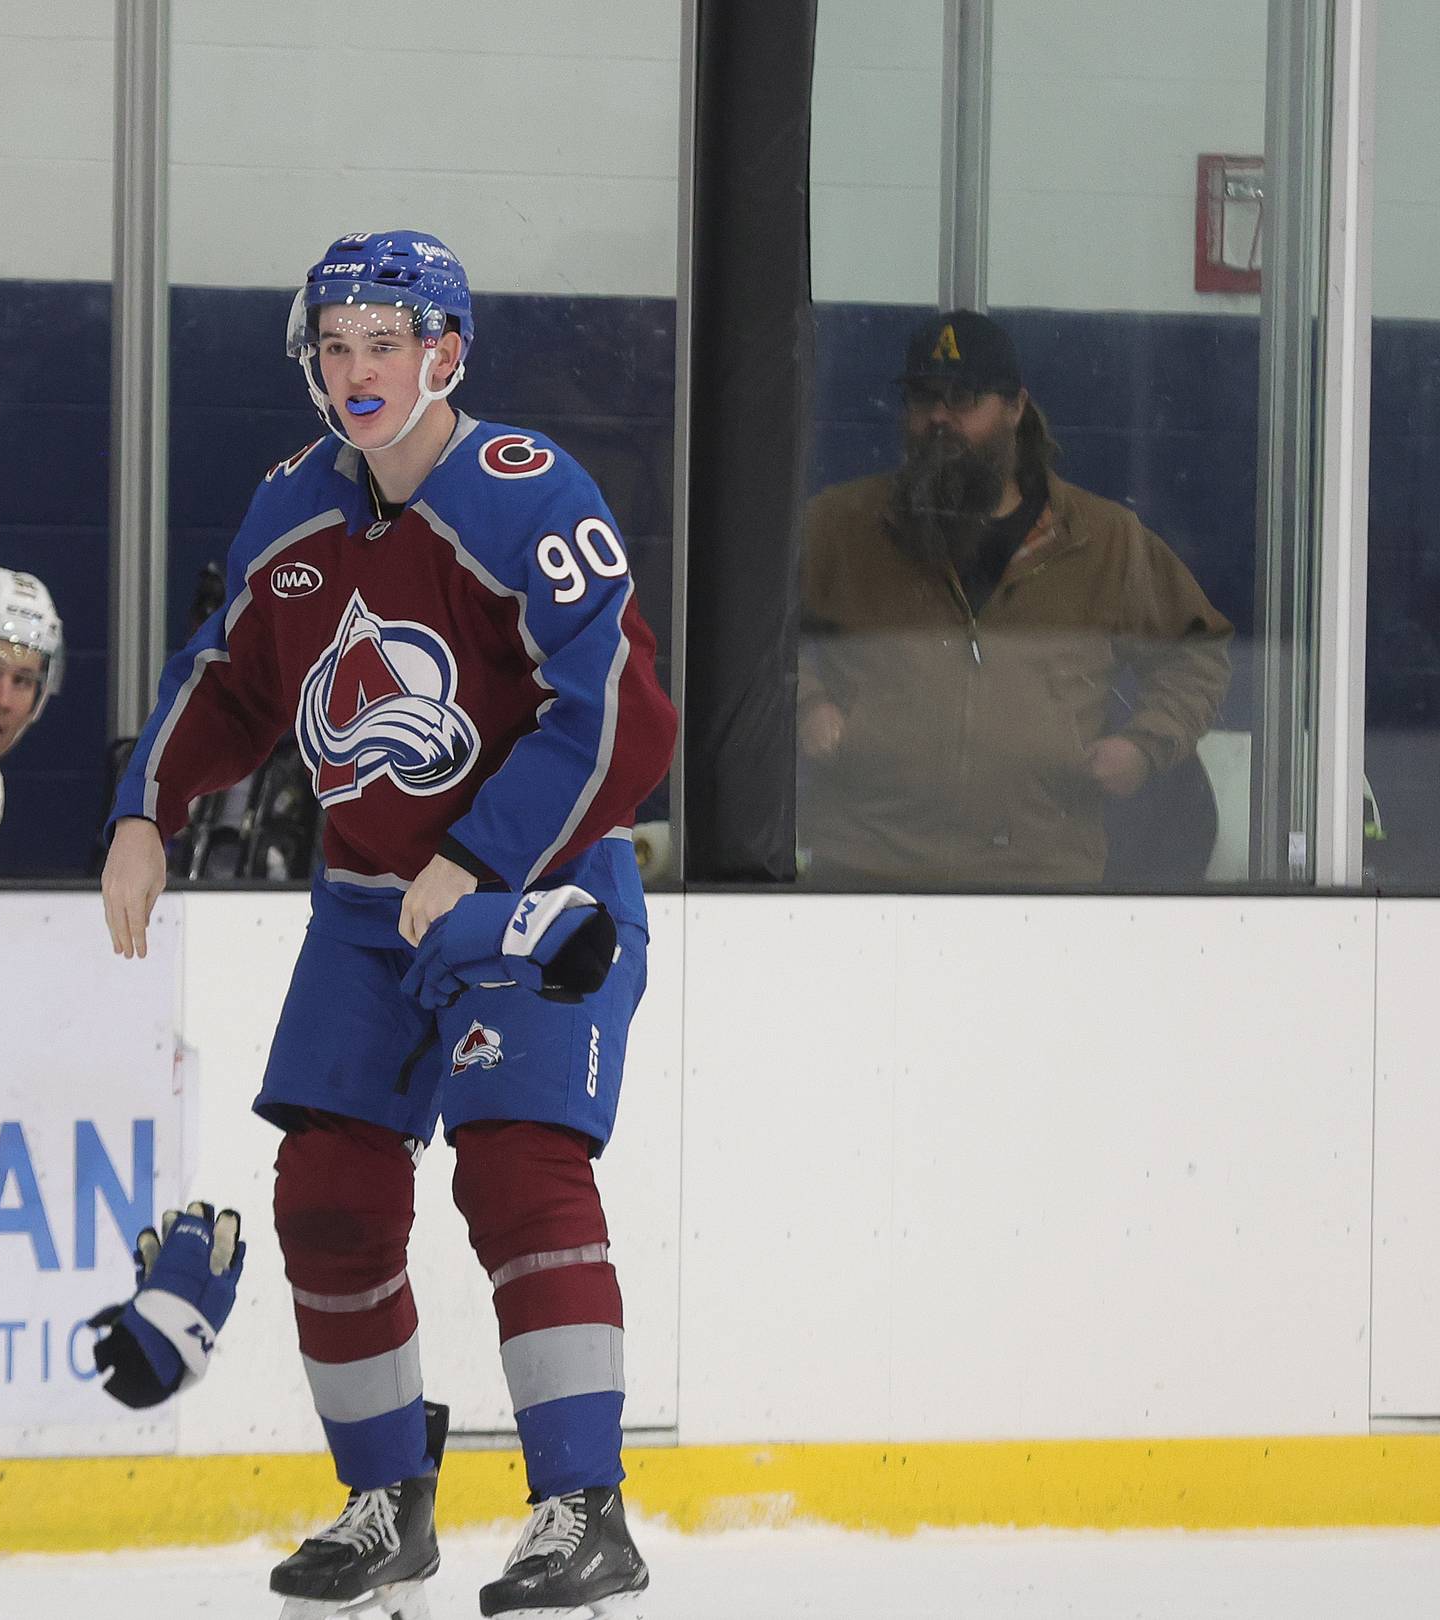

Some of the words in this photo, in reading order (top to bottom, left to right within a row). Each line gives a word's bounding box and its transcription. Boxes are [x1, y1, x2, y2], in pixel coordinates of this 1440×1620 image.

[322, 263, 366, 275] CCM
[933, 324, 961, 361] A
[536, 517, 629, 604] 90
[276, 572, 313, 589] IMA
[586, 1023, 601, 1098] CCM
